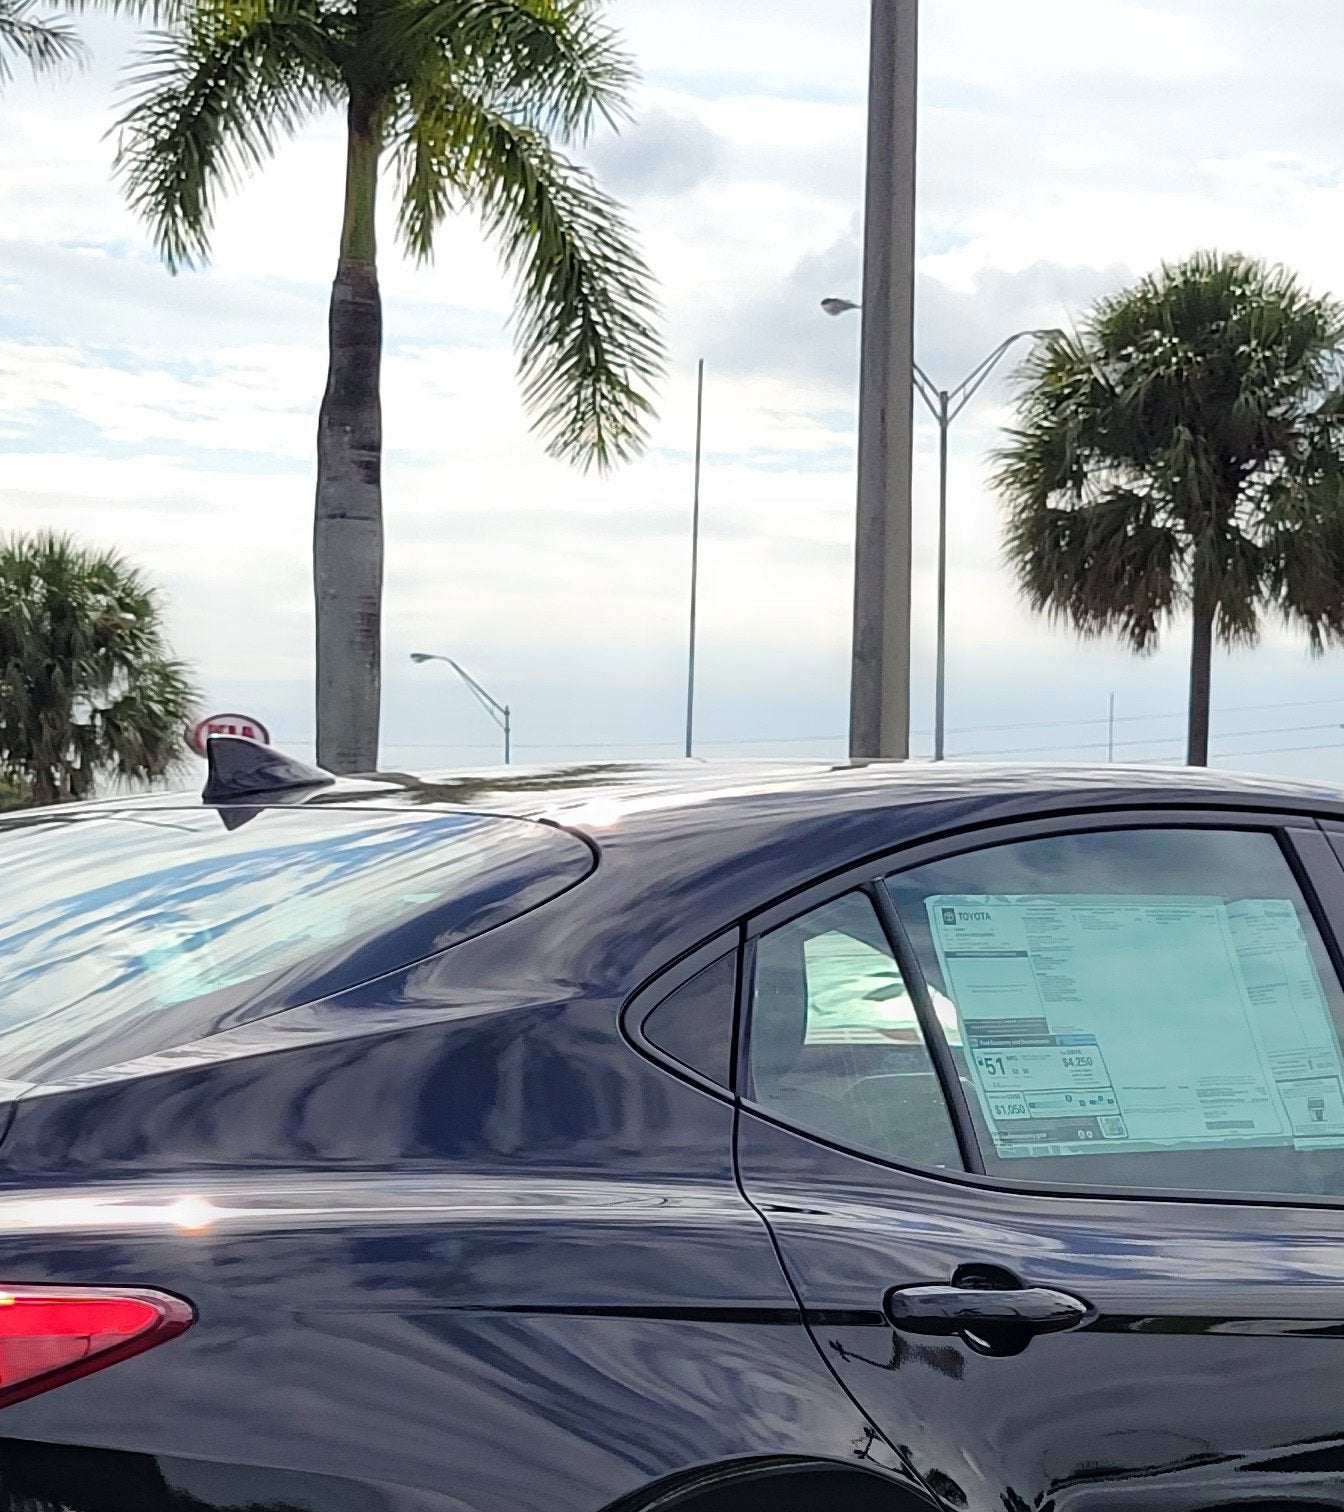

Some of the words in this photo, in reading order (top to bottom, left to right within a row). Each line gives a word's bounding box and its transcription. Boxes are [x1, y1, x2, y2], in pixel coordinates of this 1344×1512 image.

[958, 912, 992, 921] TOYOTA
[985, 1057, 1006, 1076] 51
[1062, 1057, 1093, 1068] $4,250
[994, 1105, 1026, 1116] $1,050
